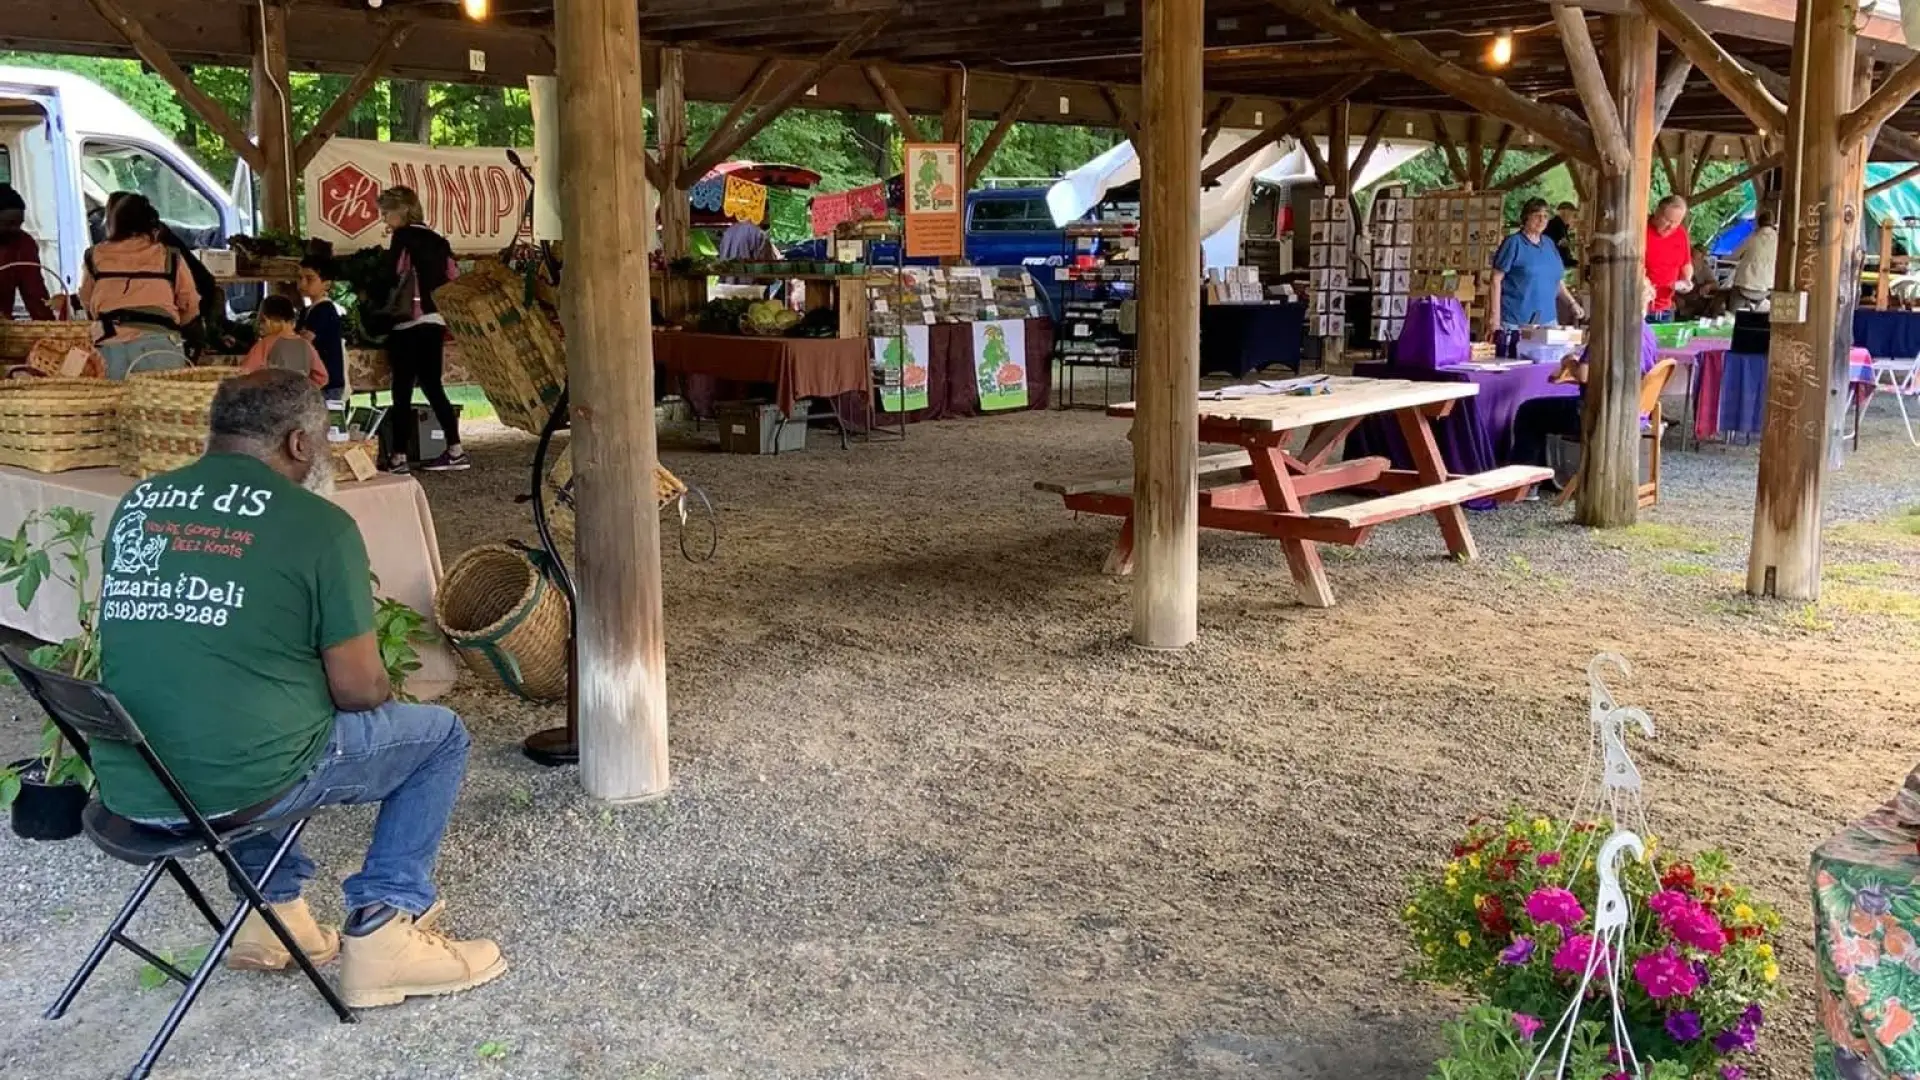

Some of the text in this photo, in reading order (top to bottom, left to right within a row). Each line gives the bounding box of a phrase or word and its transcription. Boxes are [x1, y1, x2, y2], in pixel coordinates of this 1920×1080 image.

[123, 482, 273, 516] Saint d'S
[102, 574, 172, 599] Pizzaria
[185, 576, 246, 609] Deli
[103, 600, 228, 627] (518)873-9288
